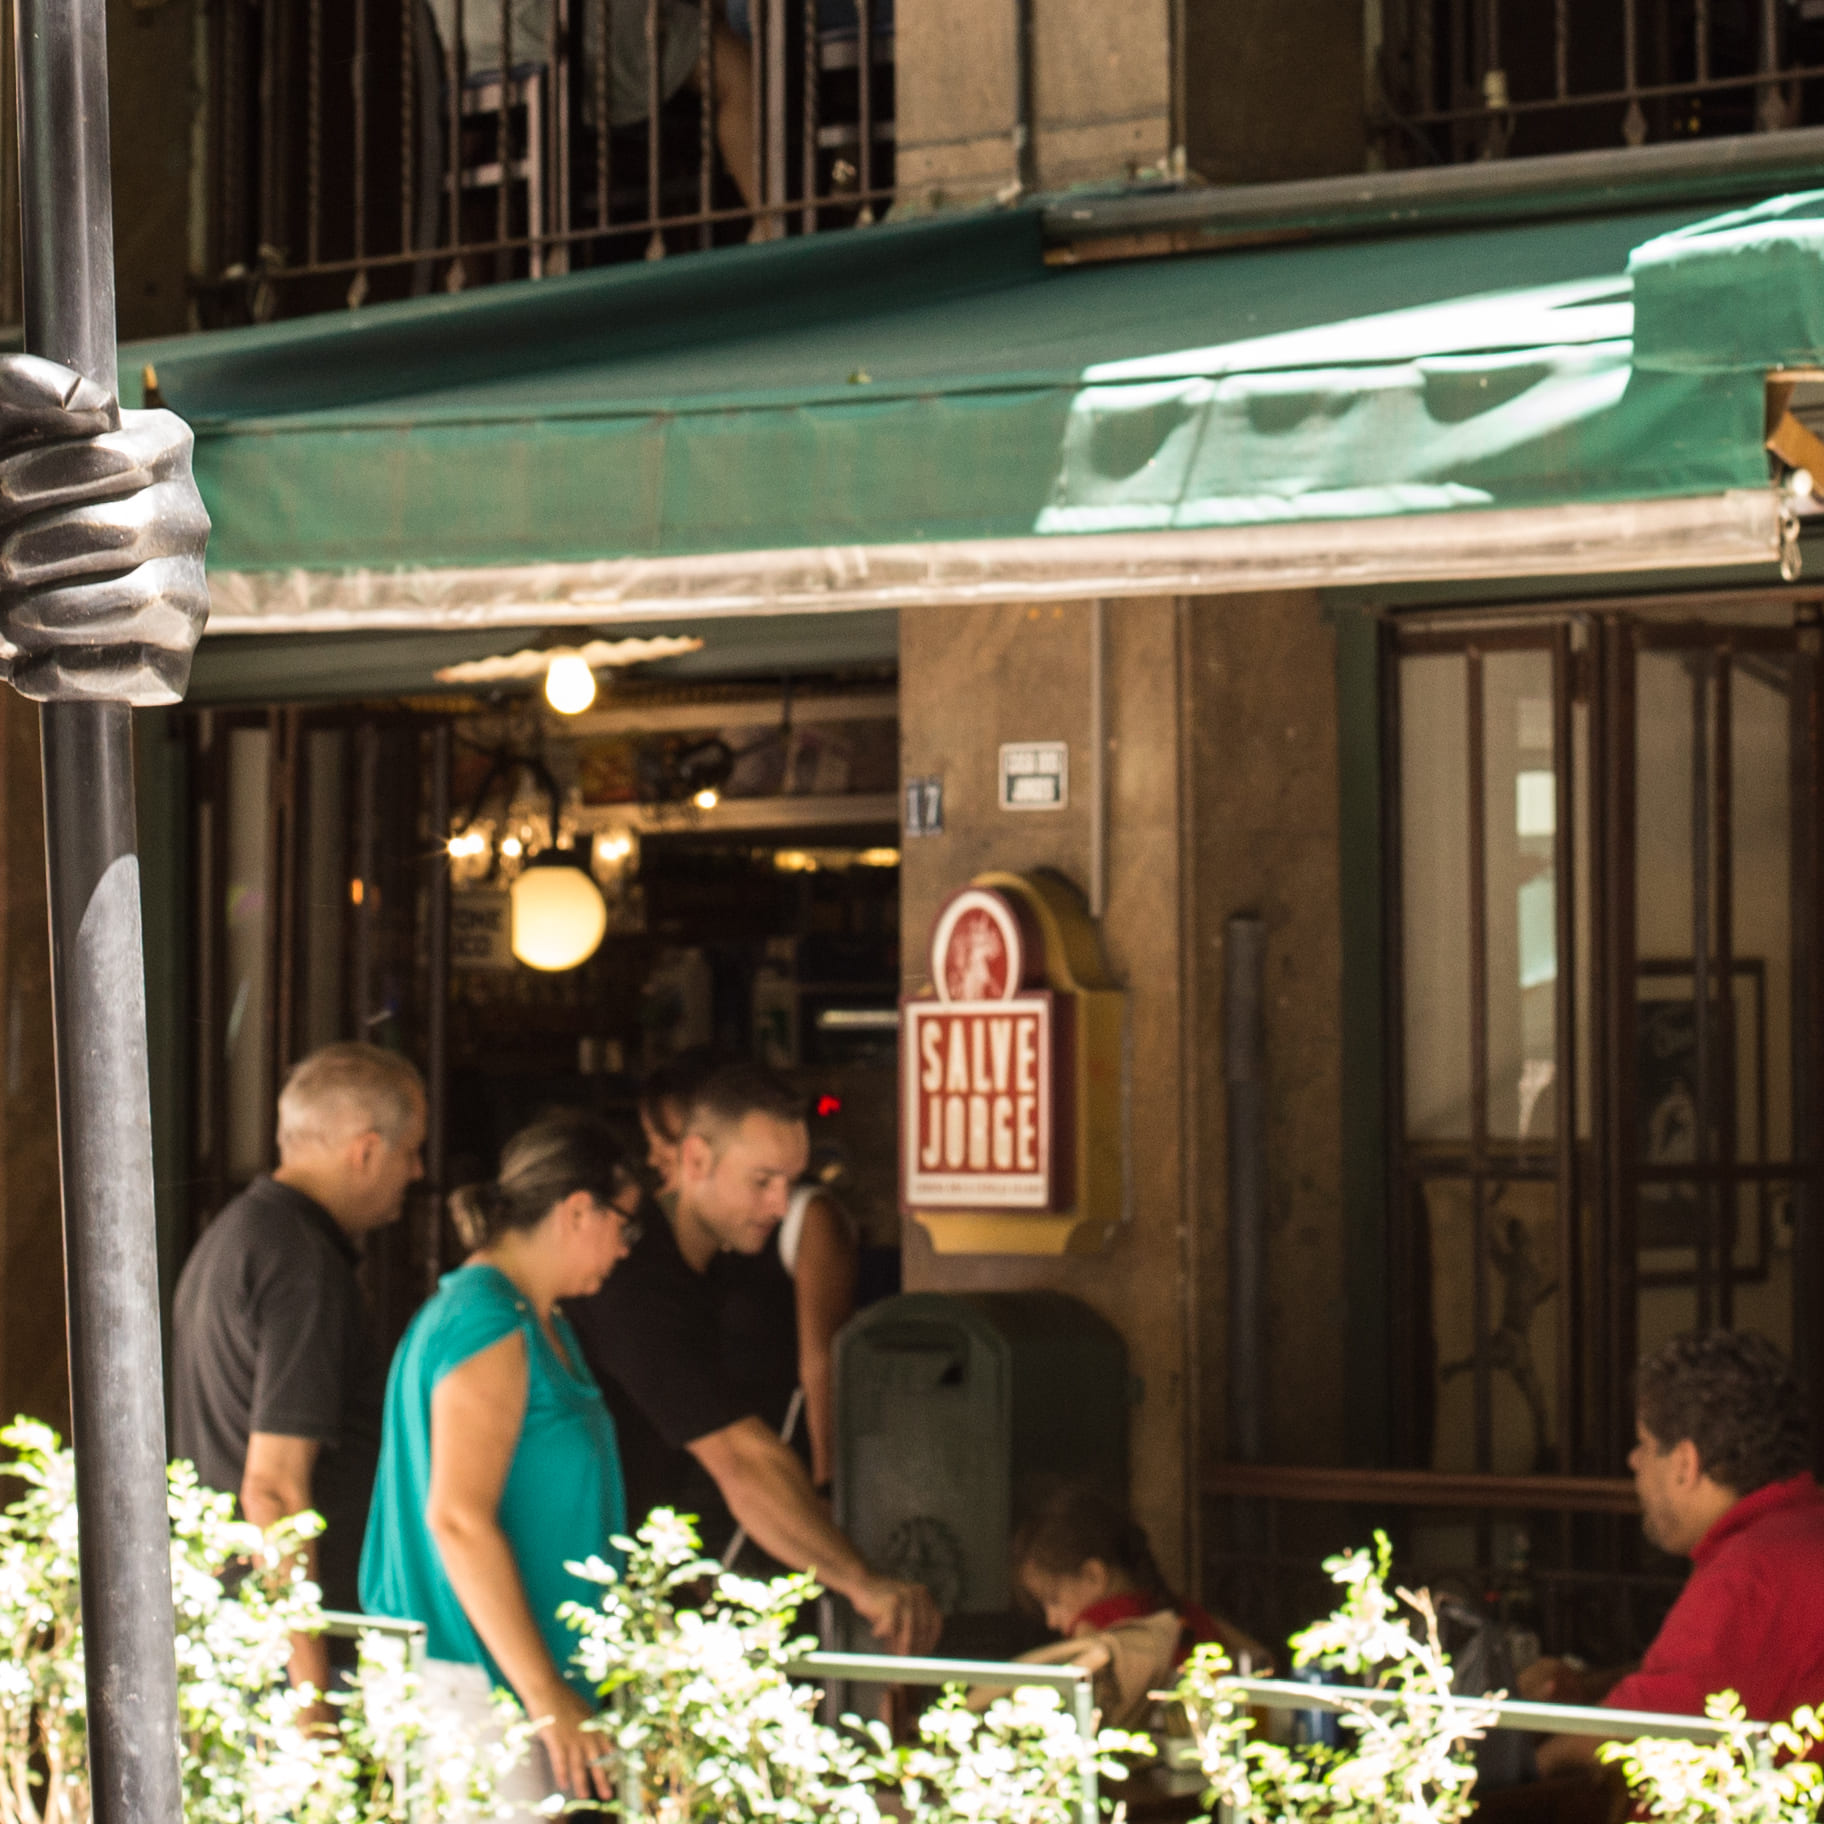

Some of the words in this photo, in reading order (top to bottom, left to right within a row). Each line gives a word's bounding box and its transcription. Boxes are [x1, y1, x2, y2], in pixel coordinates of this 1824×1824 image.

[907, 785, 940, 826] 17
[921, 1018, 1036, 1093] SALVE
[920, 1094, 1036, 1170] JORGE
